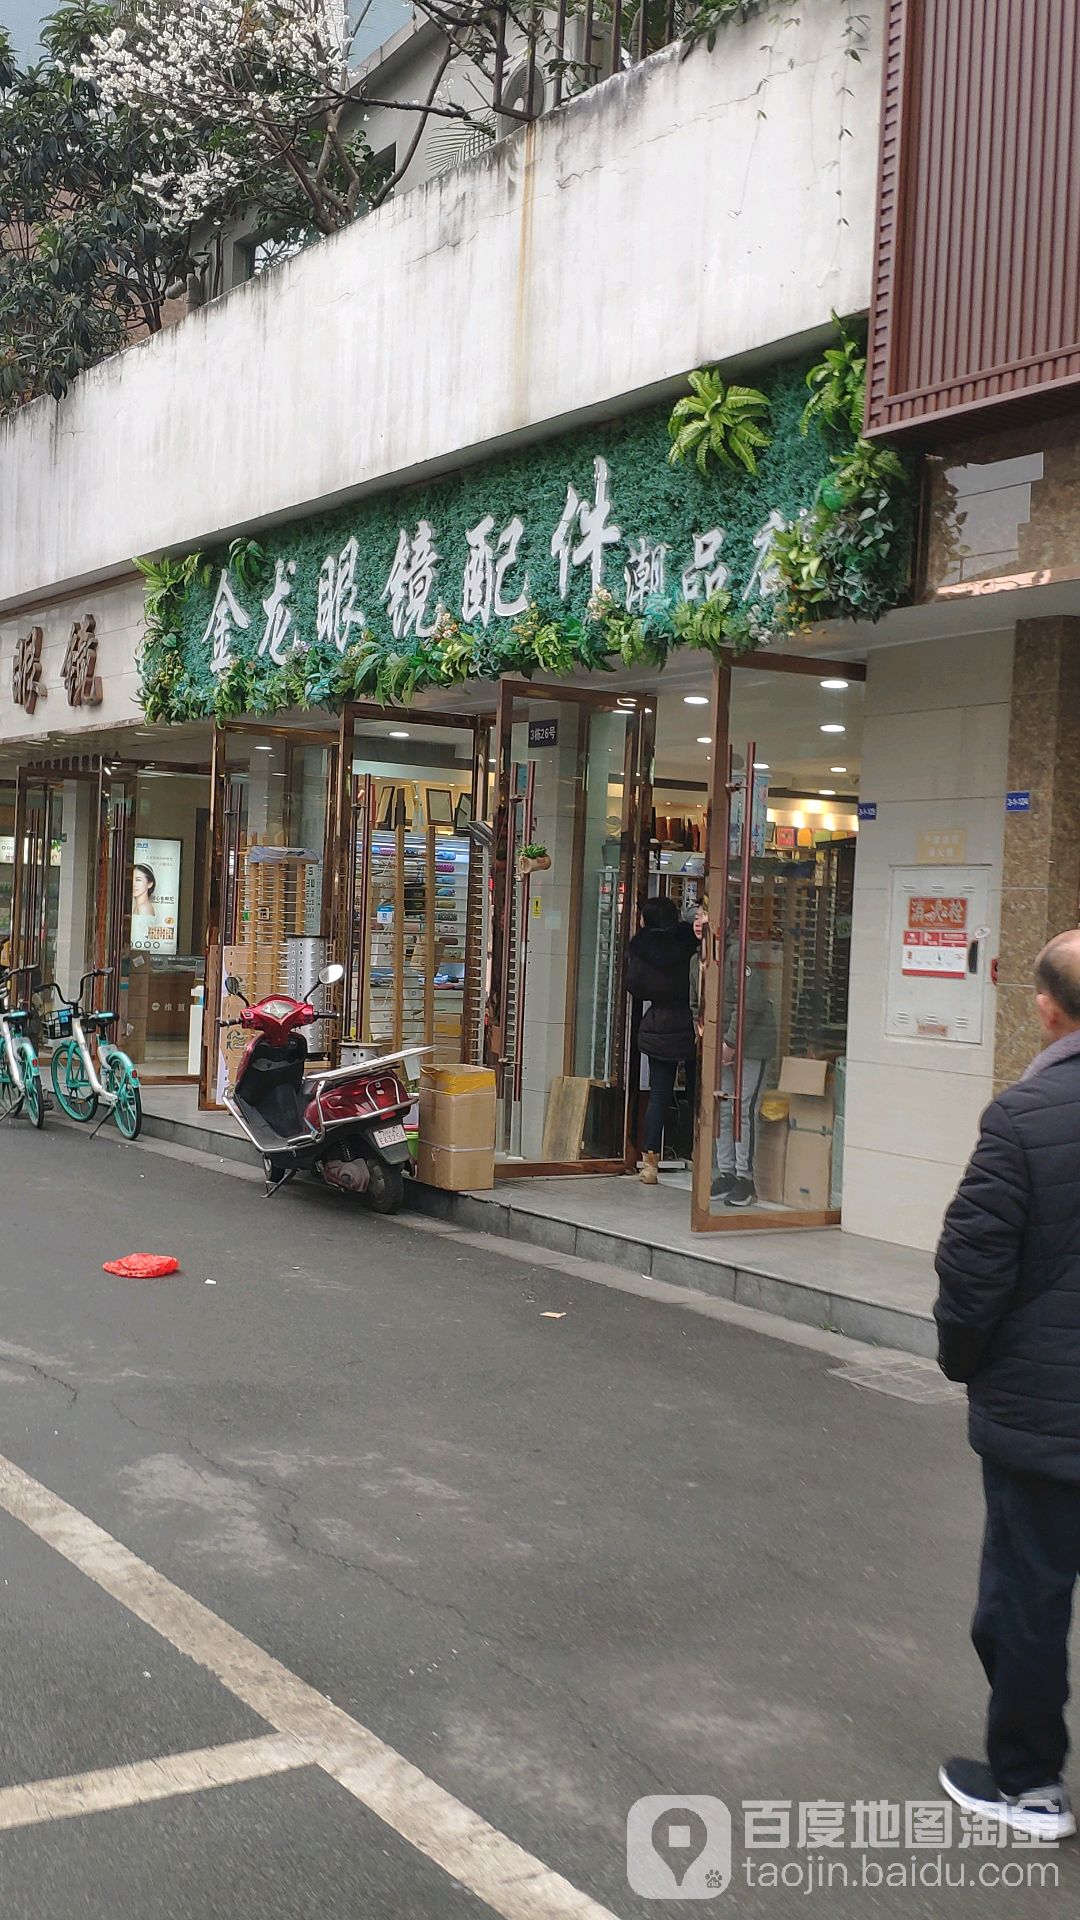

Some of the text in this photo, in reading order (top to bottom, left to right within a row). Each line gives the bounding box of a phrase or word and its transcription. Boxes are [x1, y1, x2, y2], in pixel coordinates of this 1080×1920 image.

[202, 455, 621, 673] 金龙眼镜配件
[530, 726, 556, 741] 3栋26号
